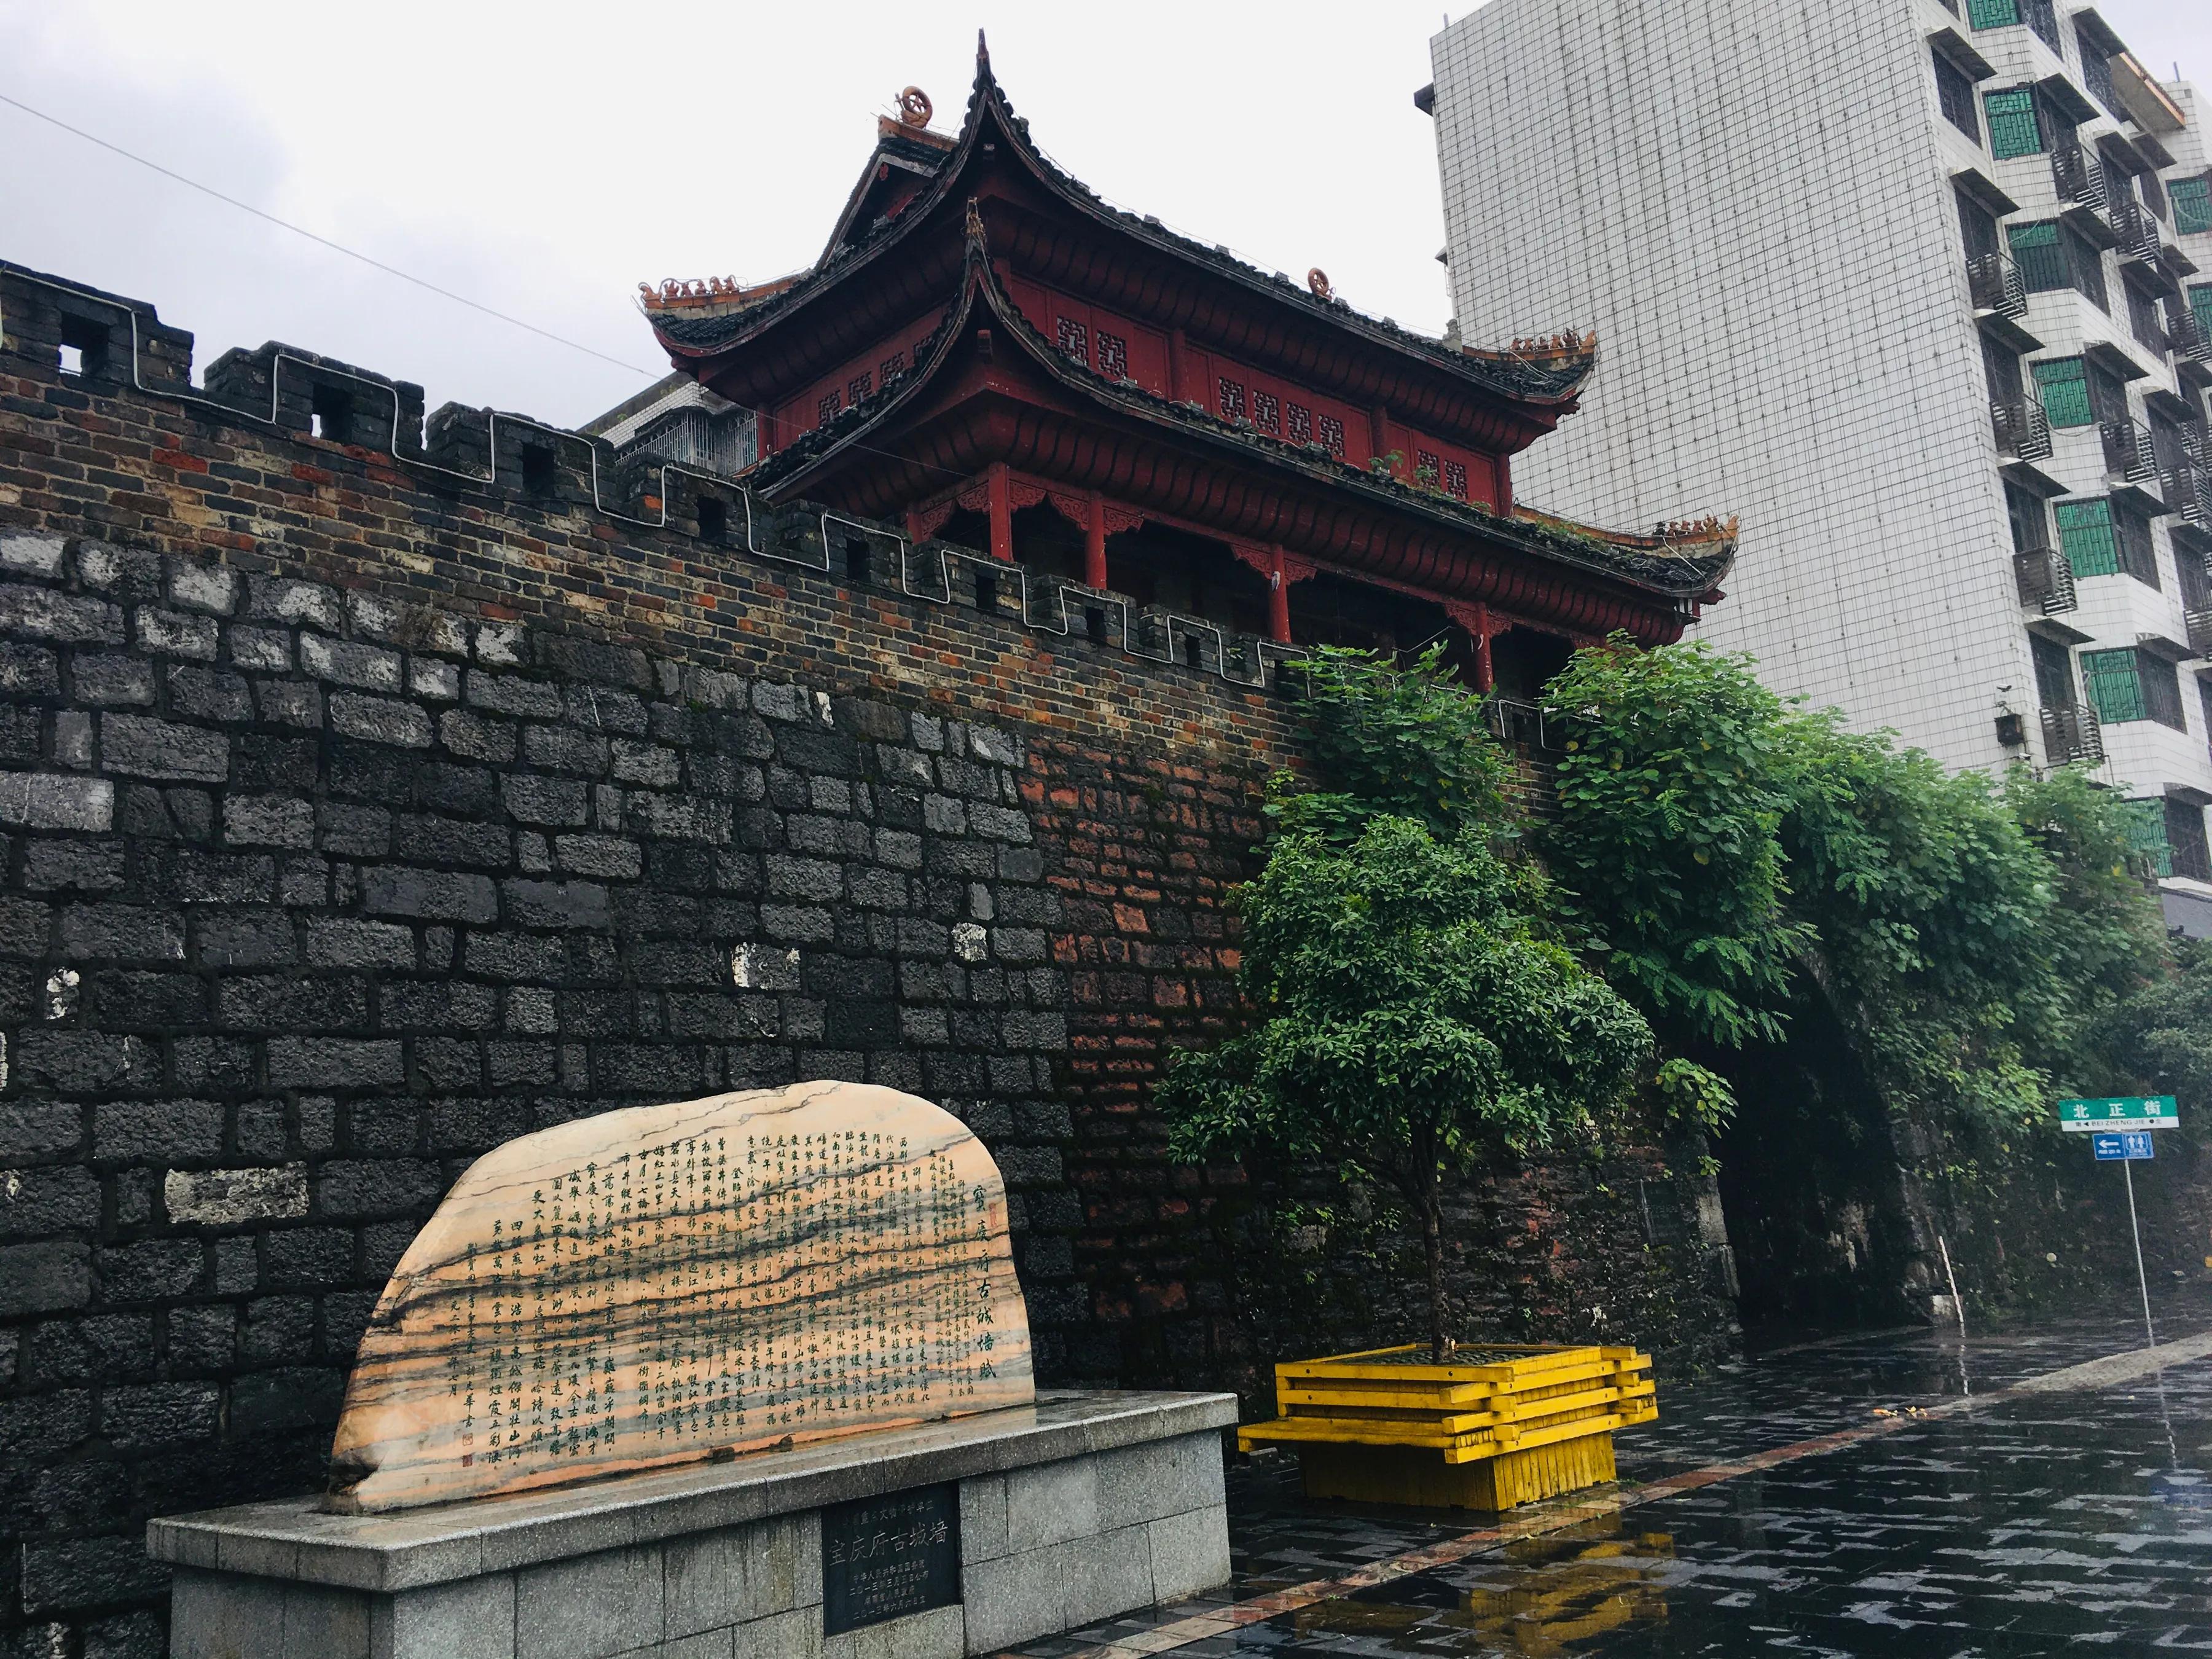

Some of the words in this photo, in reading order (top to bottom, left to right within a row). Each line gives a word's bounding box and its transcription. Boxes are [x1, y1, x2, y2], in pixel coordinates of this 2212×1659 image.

[2073, 1100, 2161, 1119] 北正街
[829, 1518, 949, 1566] 宝庆府古城墙
